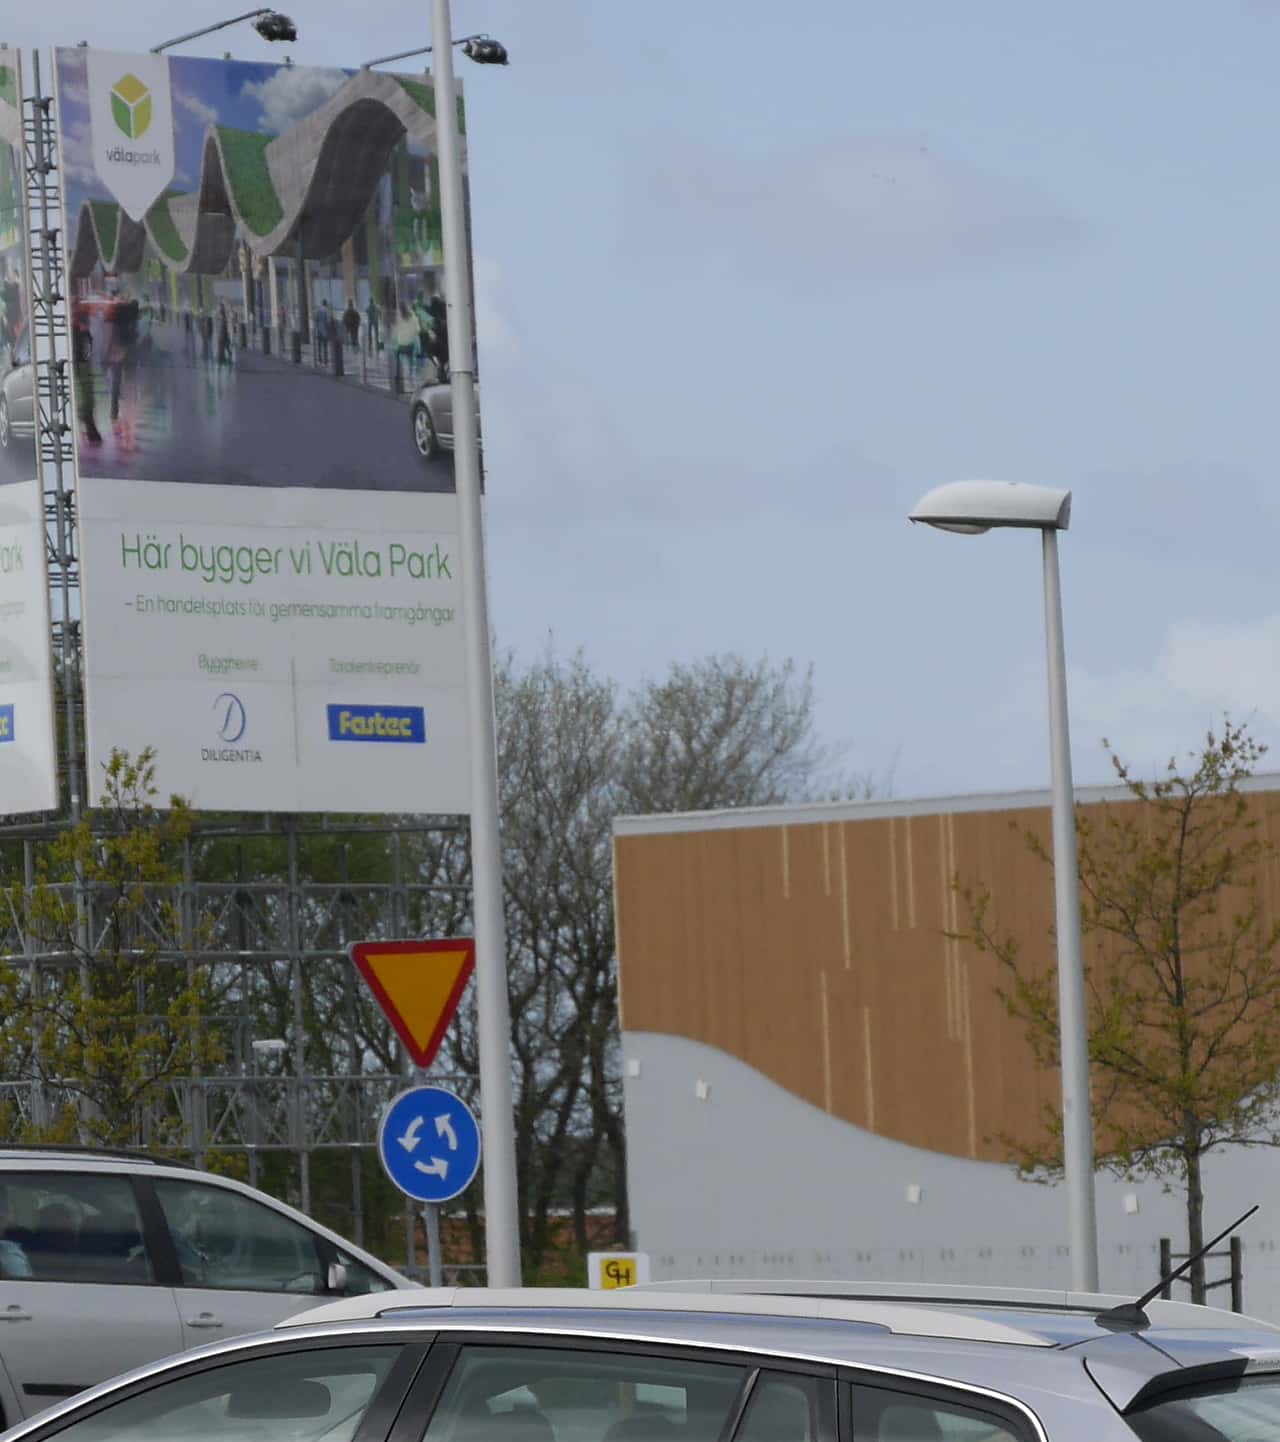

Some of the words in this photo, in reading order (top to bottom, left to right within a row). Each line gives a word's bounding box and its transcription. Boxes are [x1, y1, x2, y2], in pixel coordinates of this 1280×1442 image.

[121, 533, 171, 570] Här
[179, 534, 281, 584] bygger
[289, 540, 312, 575] vi
[317, 541, 382, 577] Väla
[388, 543, 453, 580] Park
[135, 594, 154, 612] En
[157, 595, 247, 618] handelsplats
[201, 748, 262, 763] DILIGENTIA
